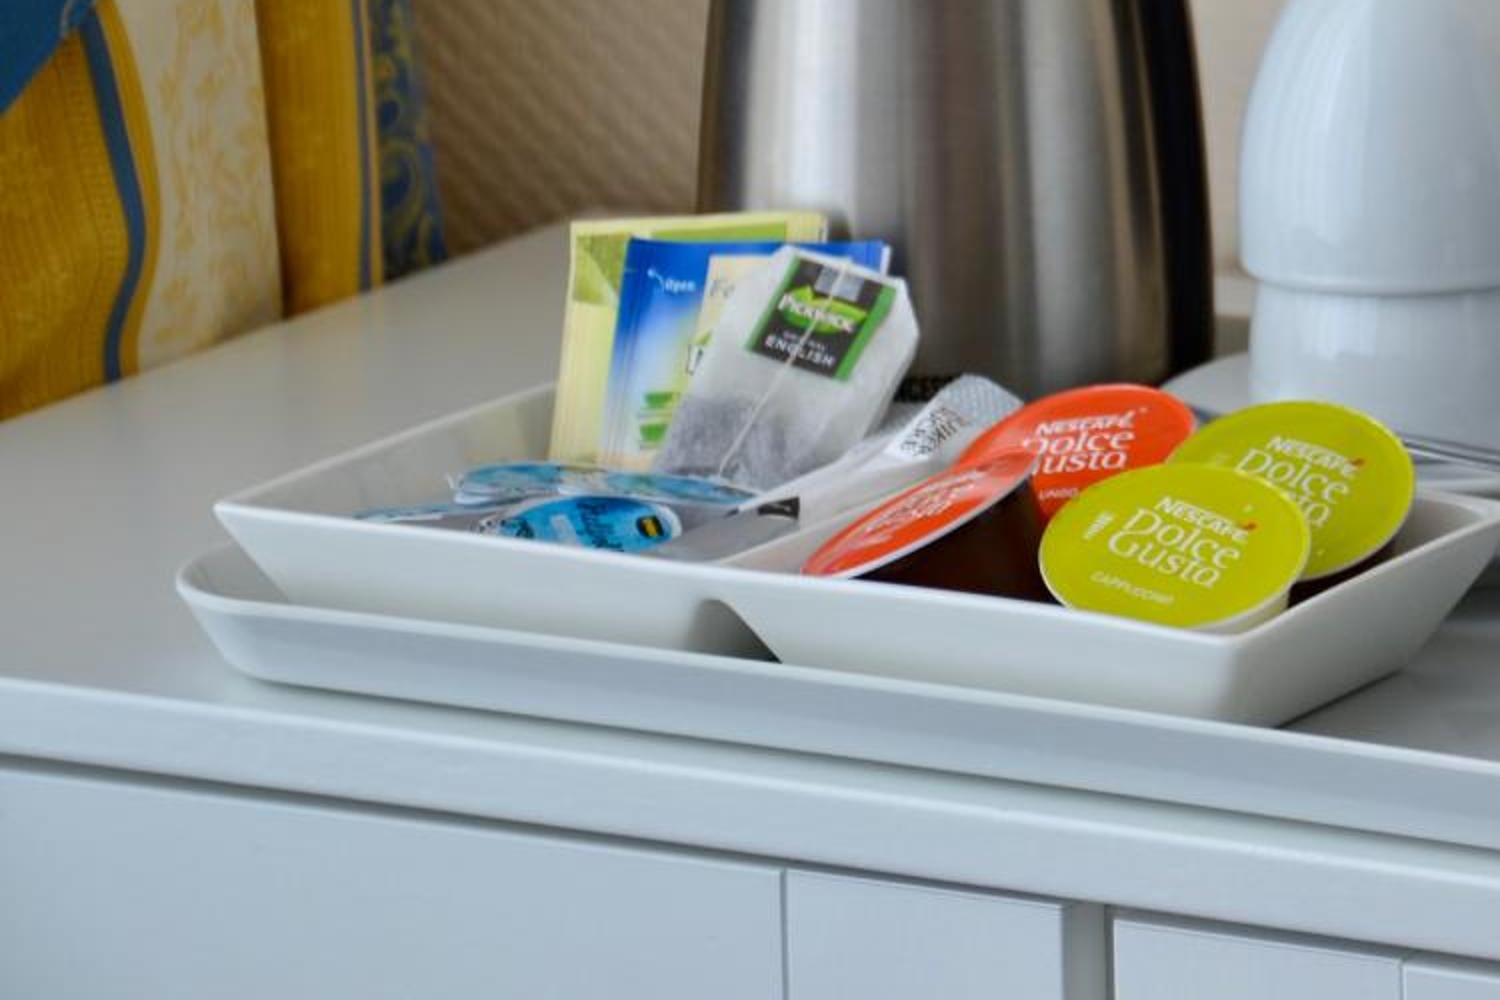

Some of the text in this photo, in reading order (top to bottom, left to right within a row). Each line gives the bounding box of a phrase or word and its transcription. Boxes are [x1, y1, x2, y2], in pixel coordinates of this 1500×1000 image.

[1042, 450, 1127, 475] usto
[1235, 448, 1348, 504] Dolce
[1108, 530, 1220, 589] Gusto
[1122, 508, 1240, 569] Dolce
